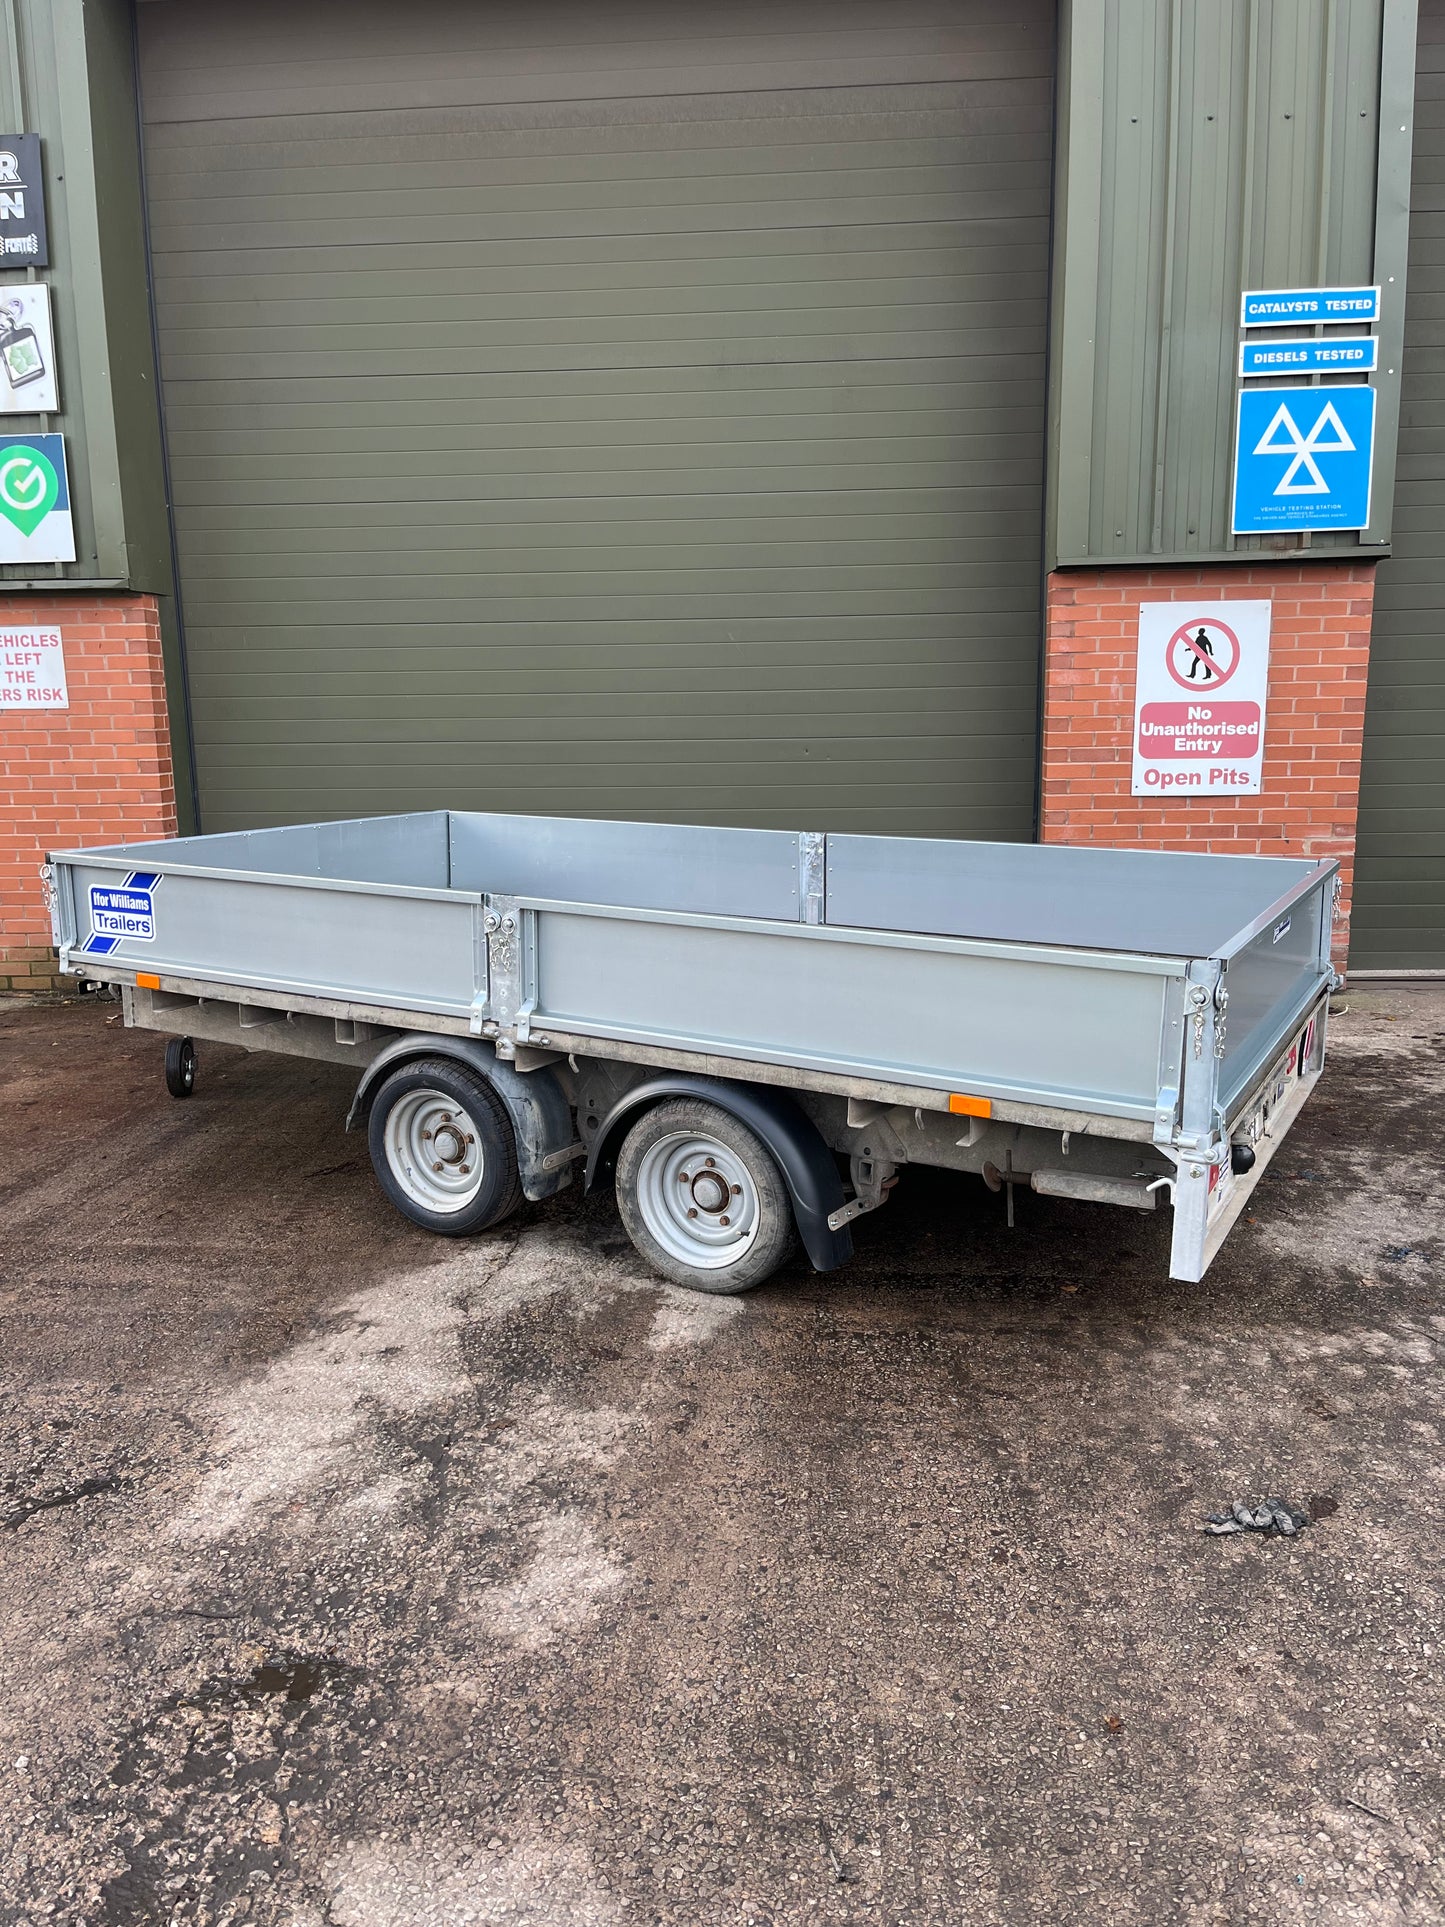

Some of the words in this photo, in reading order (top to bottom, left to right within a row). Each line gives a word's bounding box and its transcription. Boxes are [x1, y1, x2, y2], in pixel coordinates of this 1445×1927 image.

[0, 191, 25, 219] N
[1249, 300, 1319, 314] CATALYSTS
[1325, 299, 1373, 311] TESTED
[1253, 351, 1308, 364] DIESELS
[1314, 349, 1364, 361] TESTED
[5, 653, 42, 665] LEFT
[5, 671, 36, 683] THE
[27, 688, 63, 701] RISK
[1187, 706, 1212, 720] No
[1140, 721, 1258, 736] Unauthorised
[1174, 737, 1223, 754] Entry
[1143, 768, 1201, 789] Open
[1208, 768, 1250, 785] Pits
[93, 891, 109, 907] Ifor
[109, 893, 149, 911] Williams
[95, 912, 151, 933] Trailers
